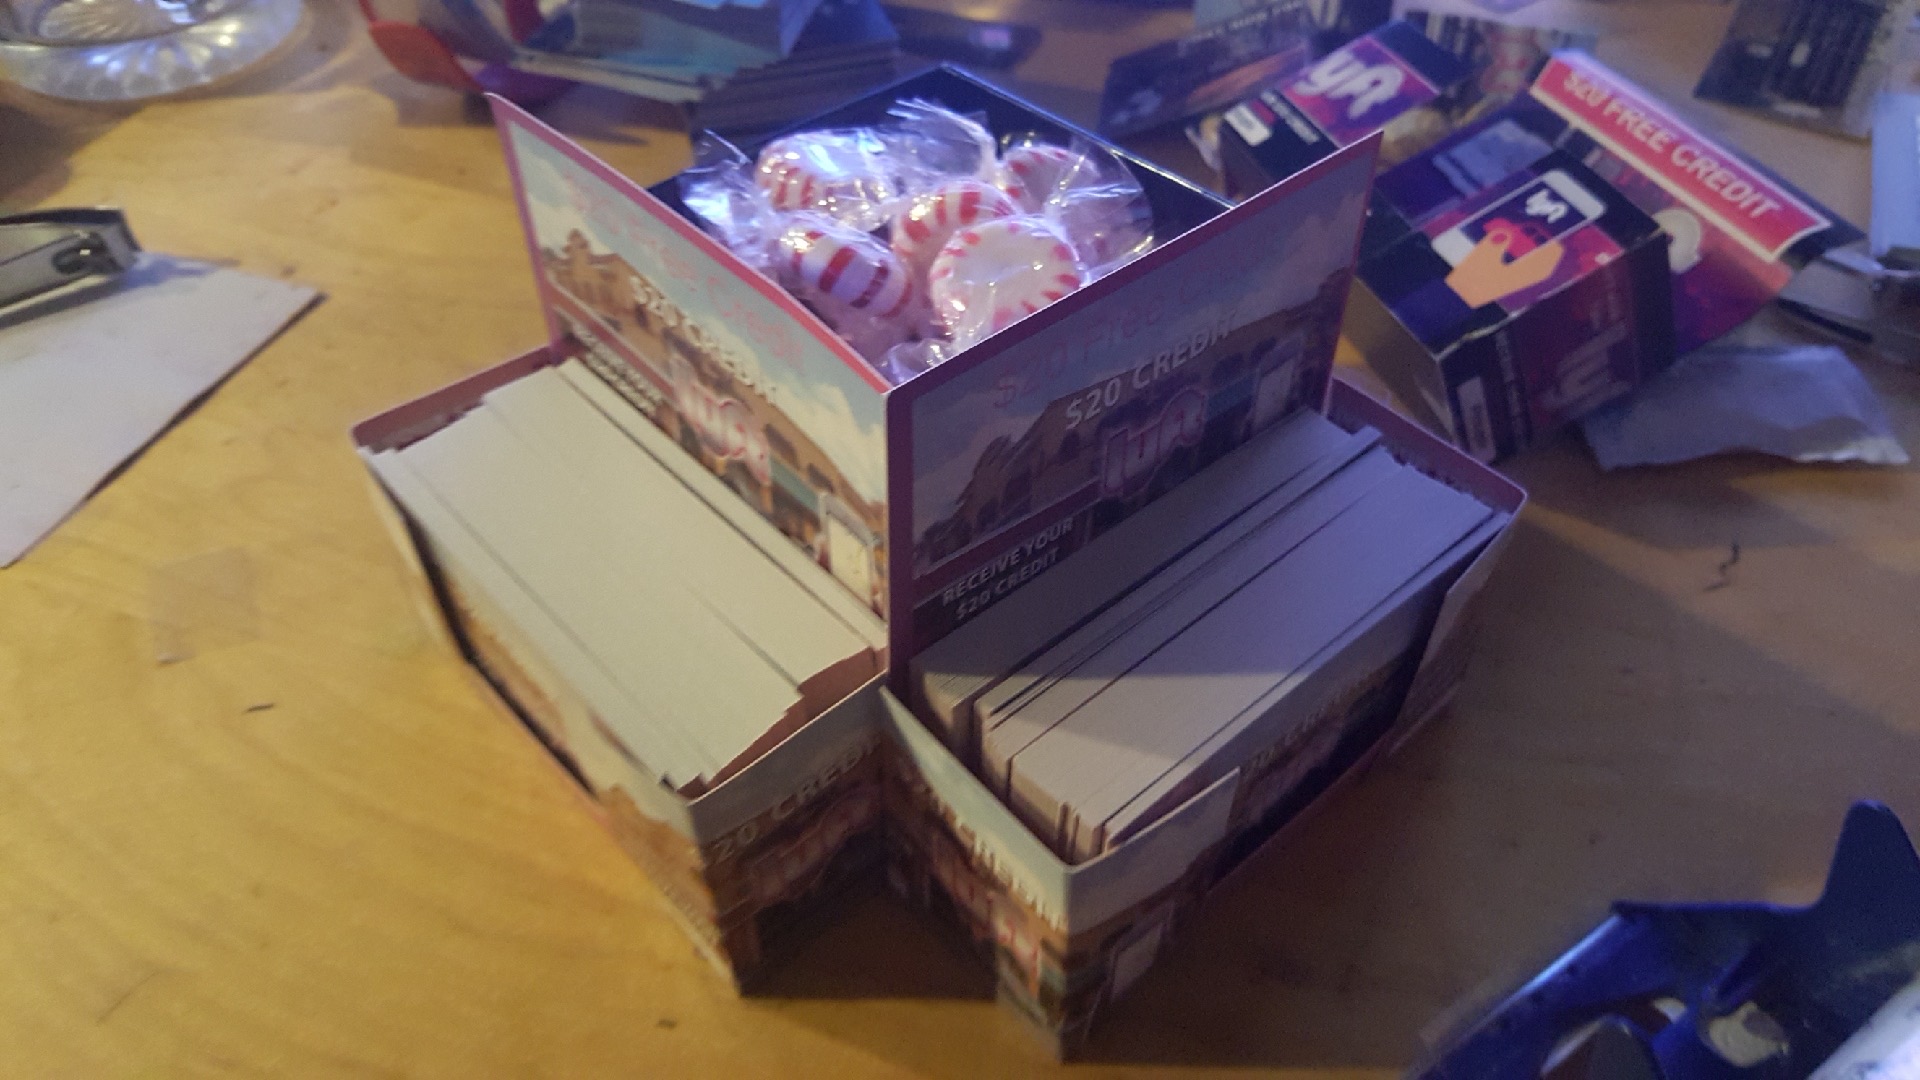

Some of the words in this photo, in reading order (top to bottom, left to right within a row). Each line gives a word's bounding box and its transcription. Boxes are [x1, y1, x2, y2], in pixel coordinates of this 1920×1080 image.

[1602, 99, 1673, 154] FREE
[1670, 144, 1782, 219] CREDIT
[1065, 377, 1121, 431] $20
[1132, 316, 1235, 390] CREDIT
[942, 547, 1021, 607] RECEIVE
[1024, 516, 1075, 557] YOUR
[956, 590, 991, 620] $20
[994, 546, 1060, 594] CREDIT
